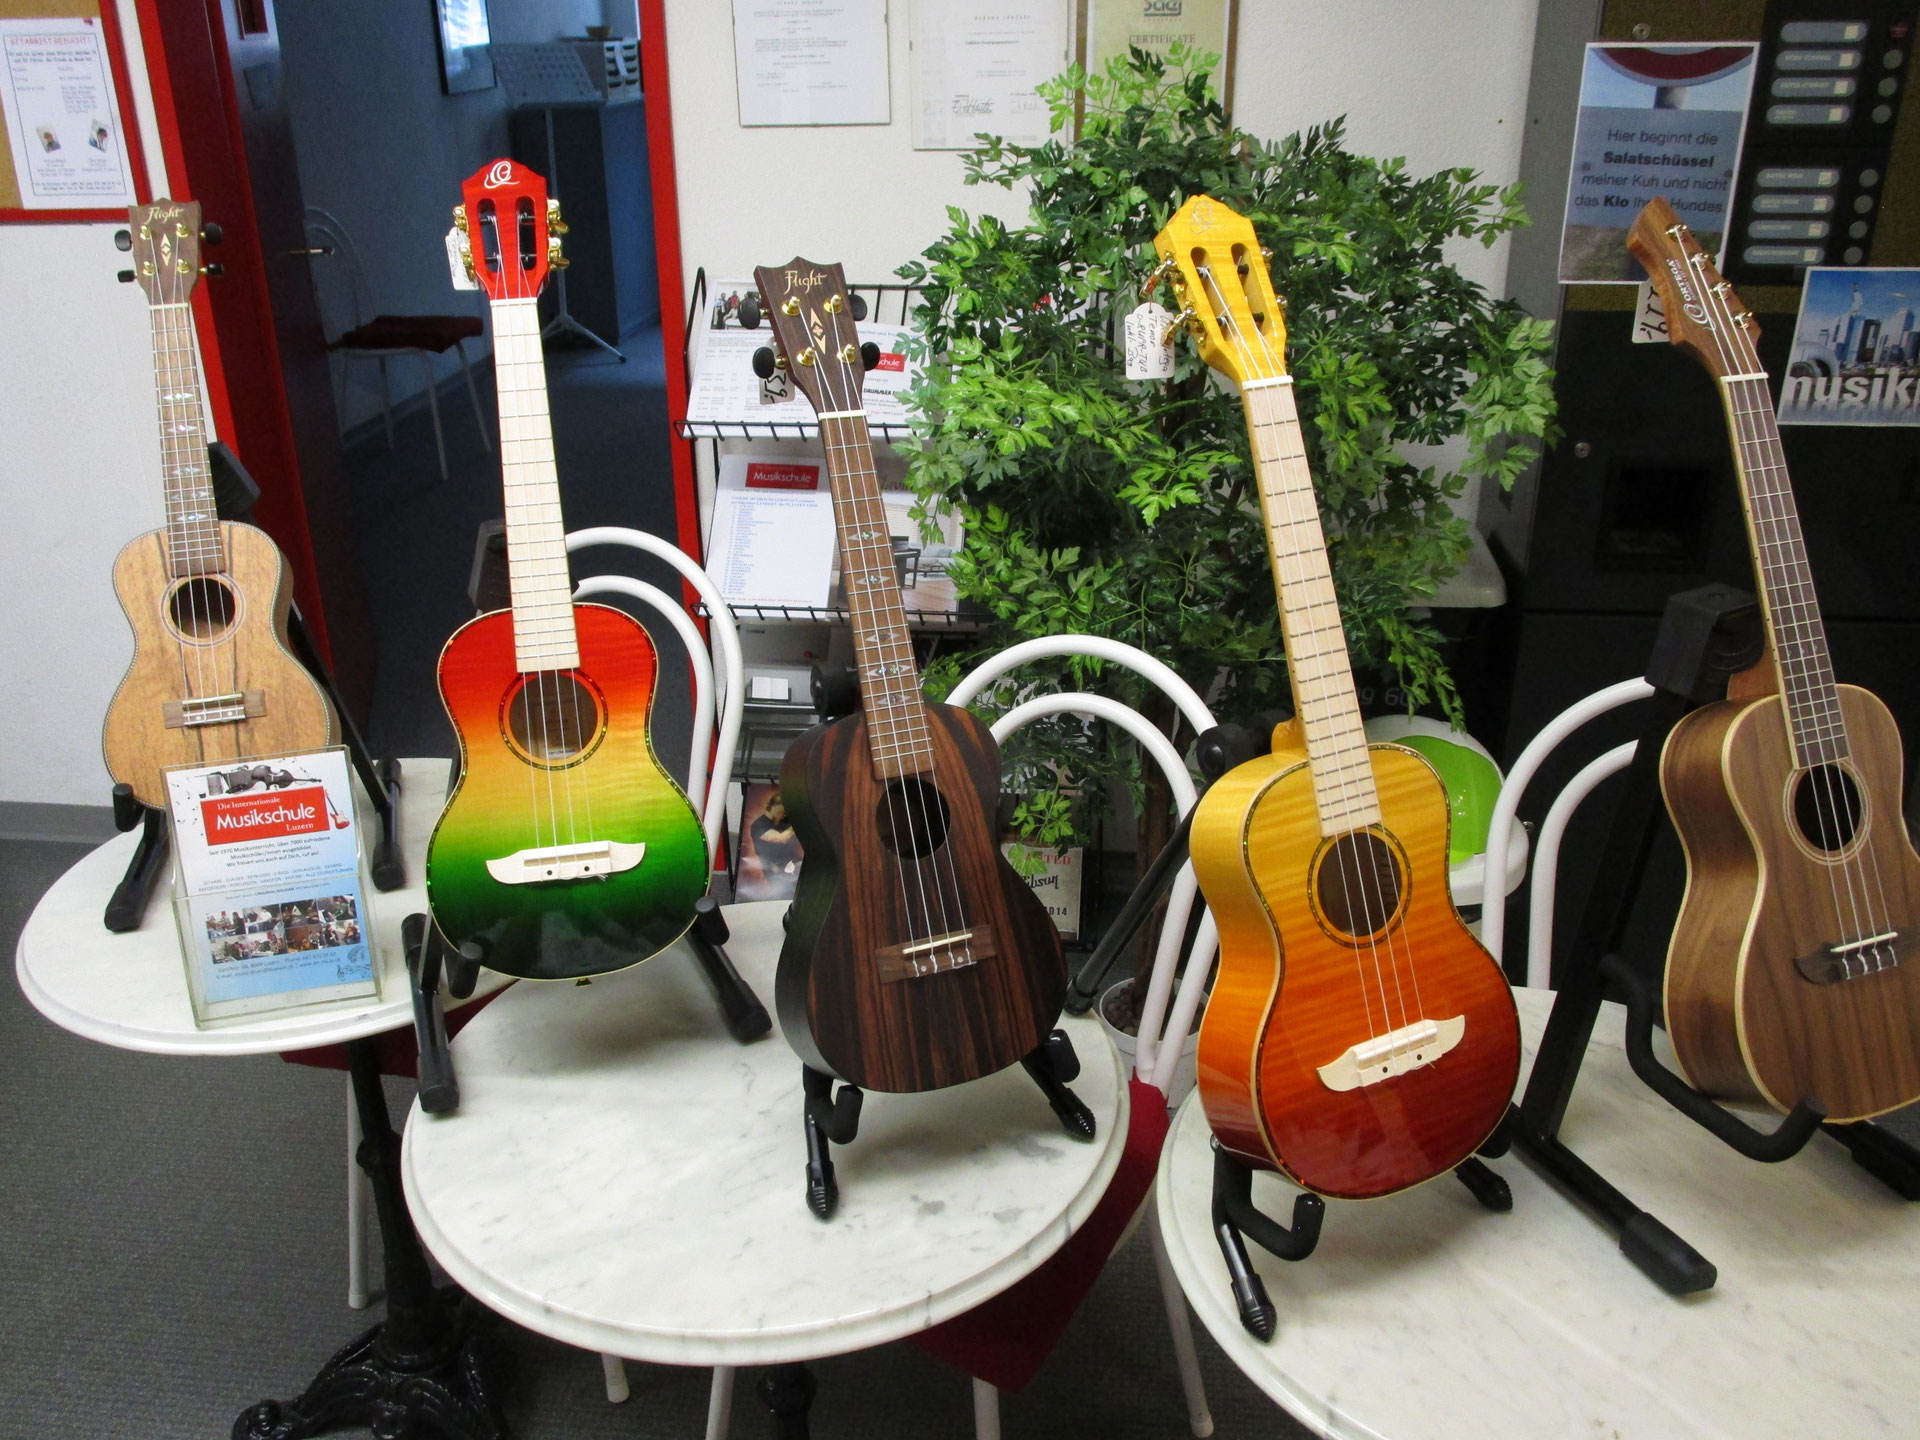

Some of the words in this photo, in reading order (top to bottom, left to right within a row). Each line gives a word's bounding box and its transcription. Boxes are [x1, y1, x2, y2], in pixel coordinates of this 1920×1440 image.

[1129, 34, 1196, 44] CERTIFICATE
[1608, 129, 1636, 143] Hier
[1640, 130, 1692, 146] beginnt
[1695, 131, 1718, 146] die
[1603, 151, 1716, 168] Salatschüssel
[1581, 174, 1628, 187] meiner
[1632, 174, 1658, 188] Kuh
[1663, 175, 1689, 189] und
[1693, 177, 1728, 192] nicht
[1574, 195, 1599, 207] das
[1603, 194, 1629, 207] Klo
[1671, 198, 1726, 213] Hundes.
[144, 206, 184, 225] Flight
[784, 269, 828, 294] Flight
[753, 471, 812, 483] Musikschule
[217, 802, 231, 811] Die
[232, 797, 280, 809] Internationale
[217, 803, 316, 830] Musikschule
[286, 823, 314, 832] Luzern
[1022, 874, 1060, 890] ibson
